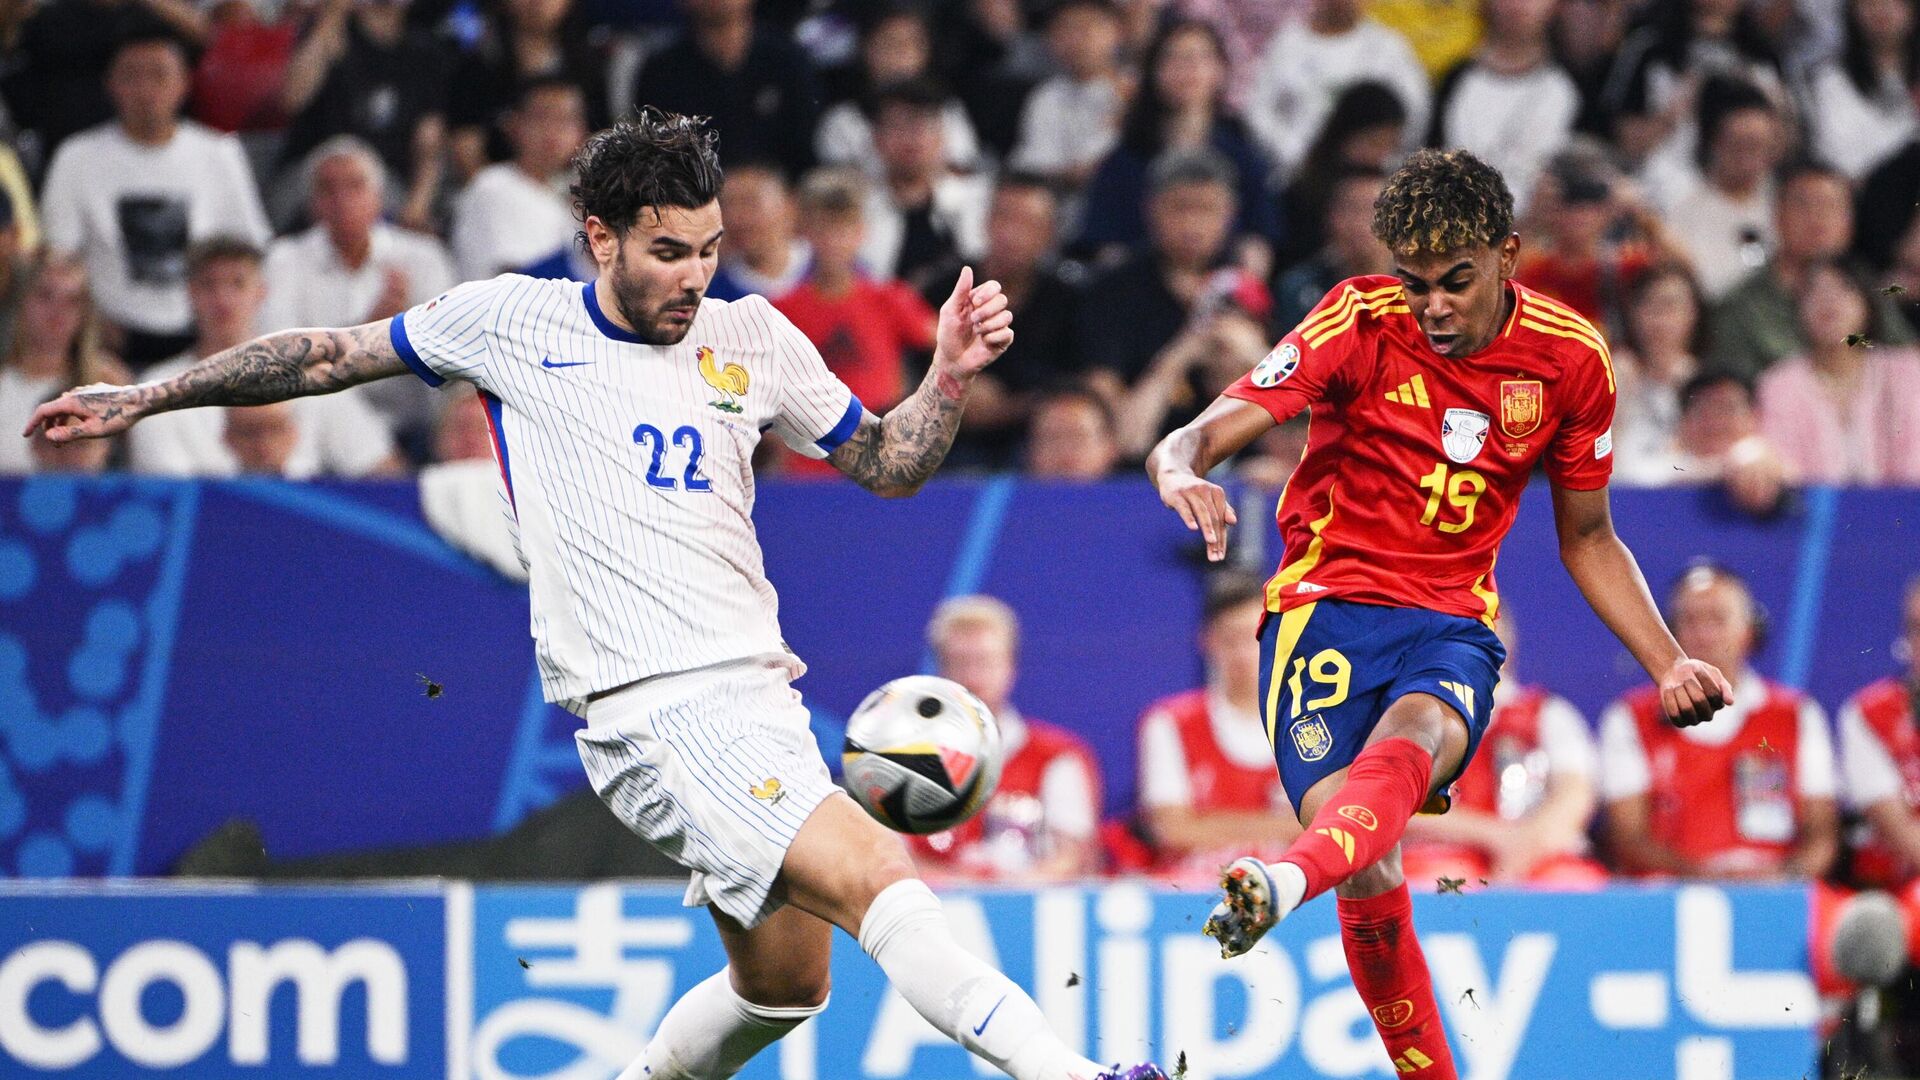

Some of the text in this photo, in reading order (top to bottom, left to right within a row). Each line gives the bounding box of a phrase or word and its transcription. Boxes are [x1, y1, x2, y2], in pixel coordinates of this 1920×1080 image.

[633, 424, 713, 493] 22
[1419, 462, 1487, 534] 19
[1287, 648, 1352, 719] 19
[0, 938, 408, 1070] com
